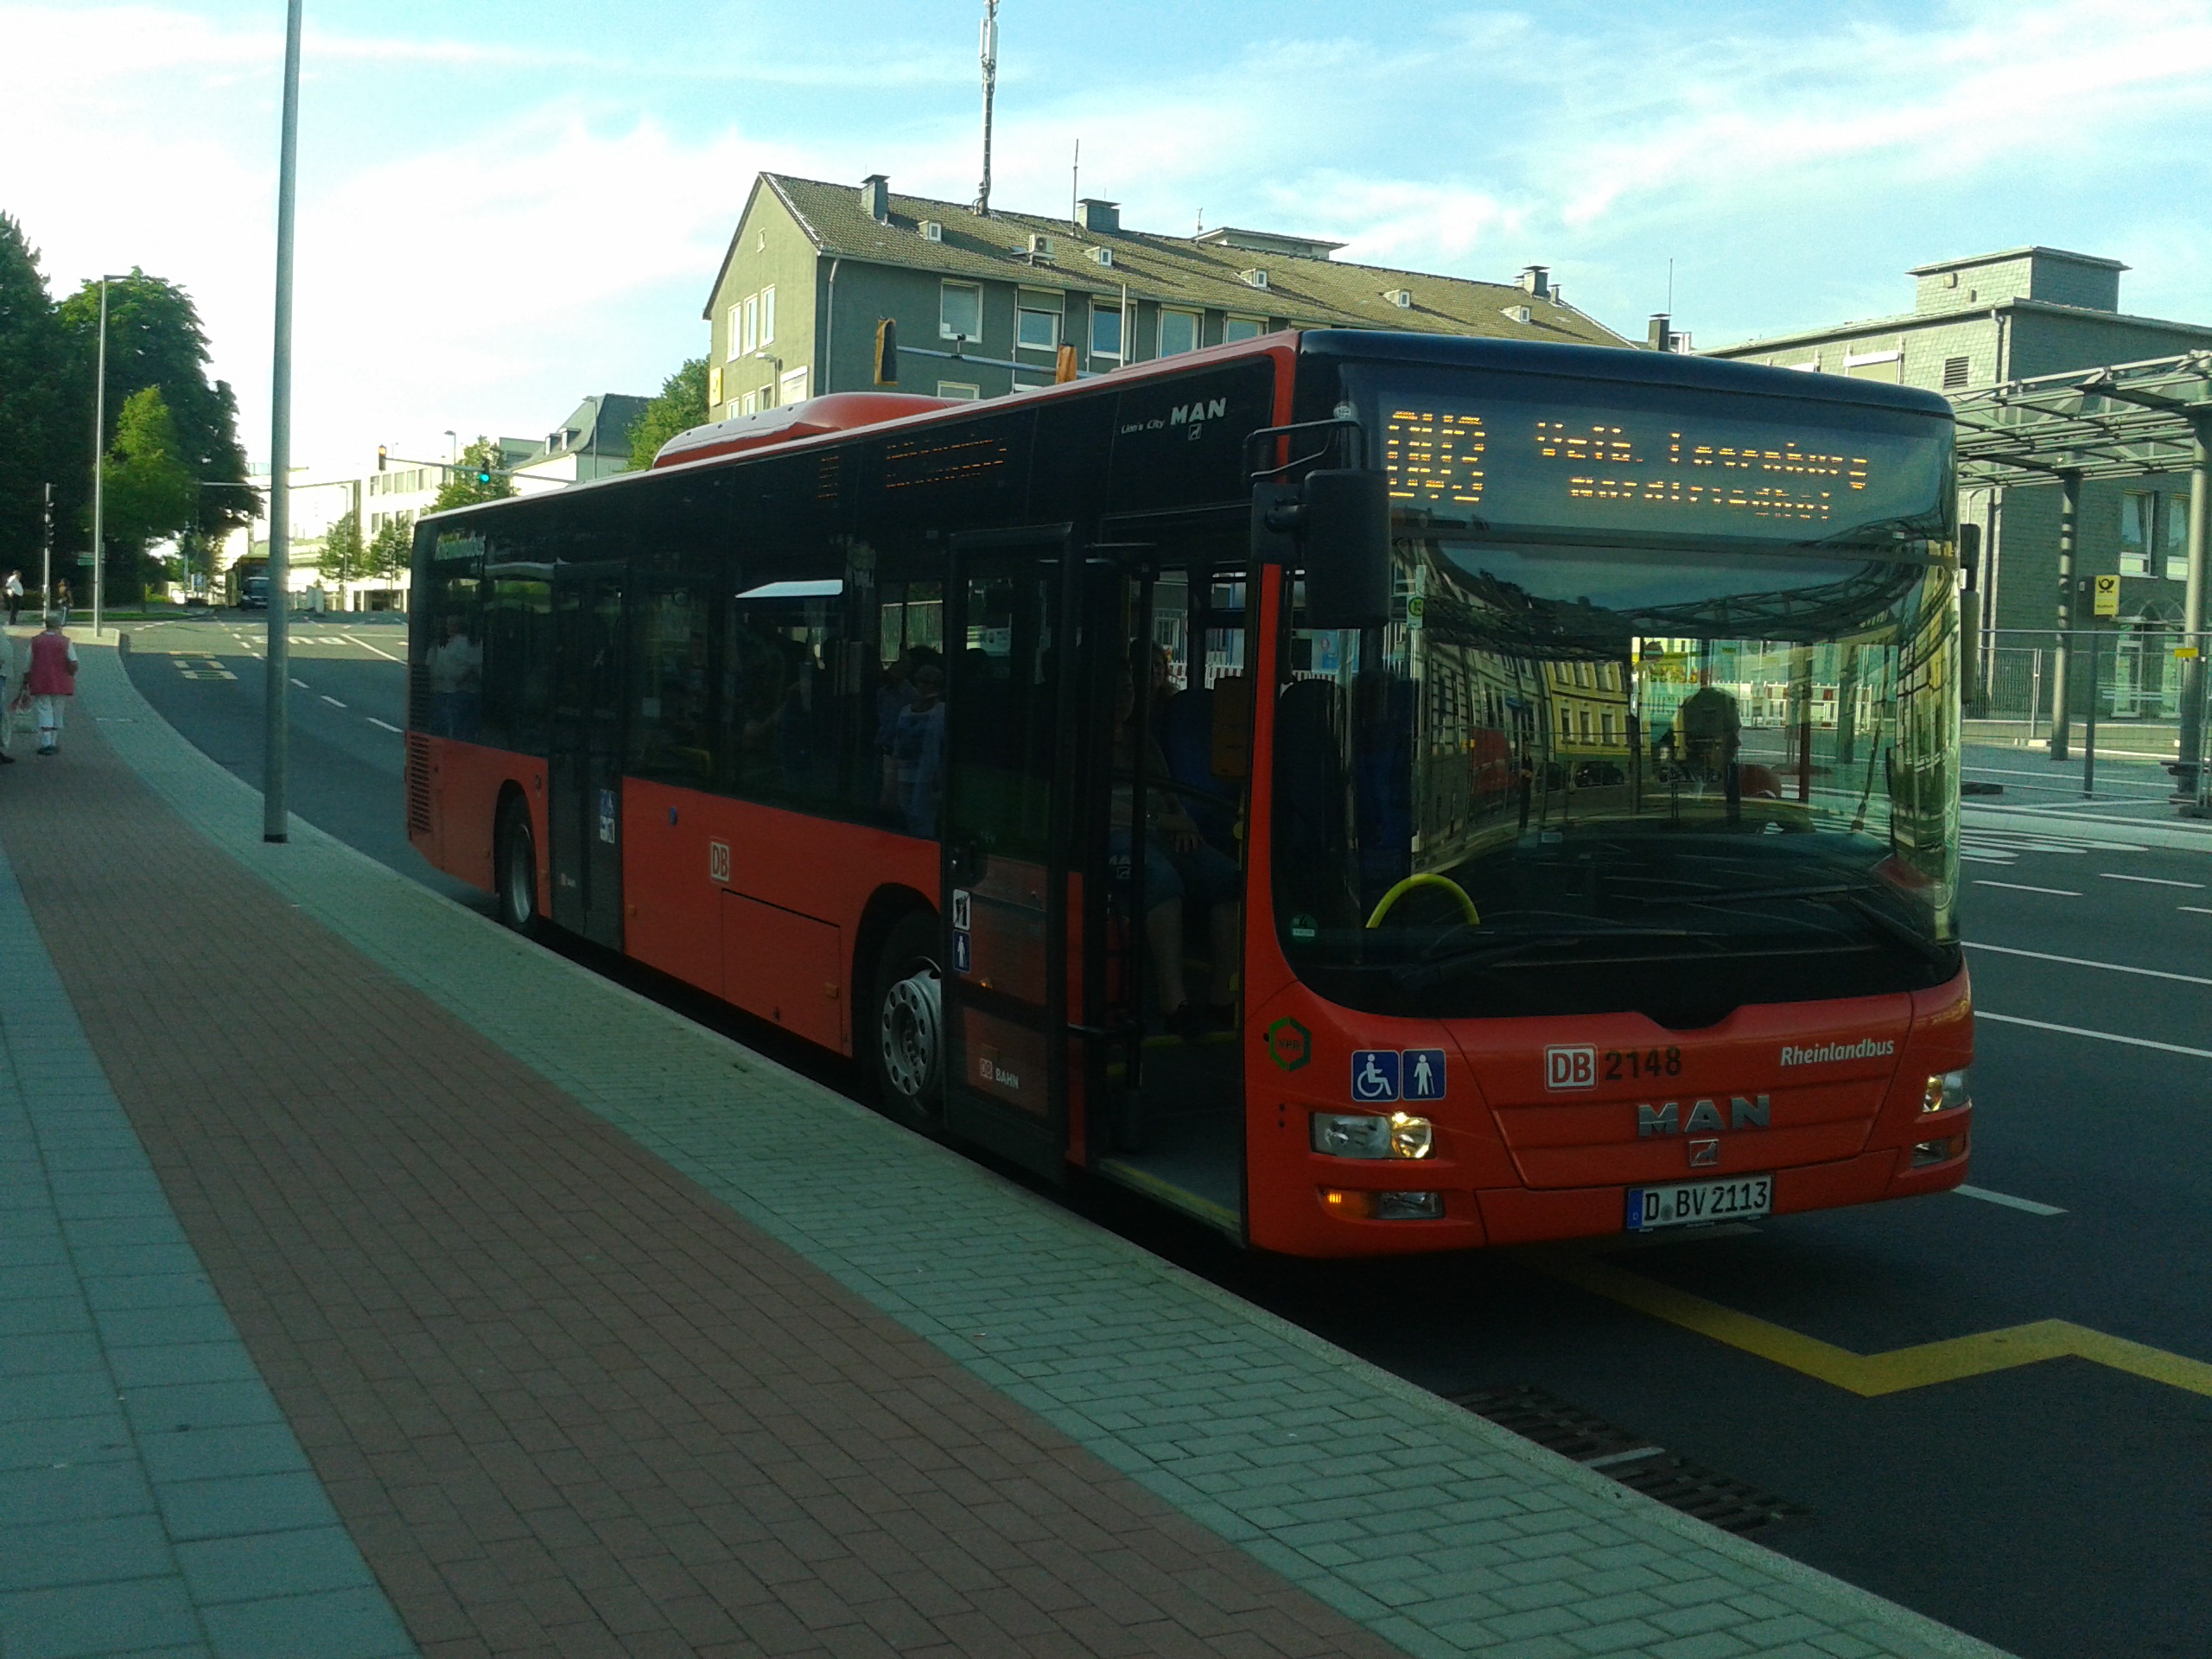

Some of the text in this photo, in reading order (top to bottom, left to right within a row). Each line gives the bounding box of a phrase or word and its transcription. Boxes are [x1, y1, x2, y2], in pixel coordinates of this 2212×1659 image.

[1170, 397, 1227, 425] MAN
[712, 845, 728, 877] DB
[1299, 915, 1308, 929] 4
[1552, 1052, 1592, 1084] DB
[1605, 1046, 1682, 1081] 2148
[1781, 1038, 1894, 1066] Rheinlandbus
[995, 1067, 1020, 1090] BAHN
[1638, 1095, 1770, 1136] MAN
[1644, 1180, 1768, 1221] D BV 2113
